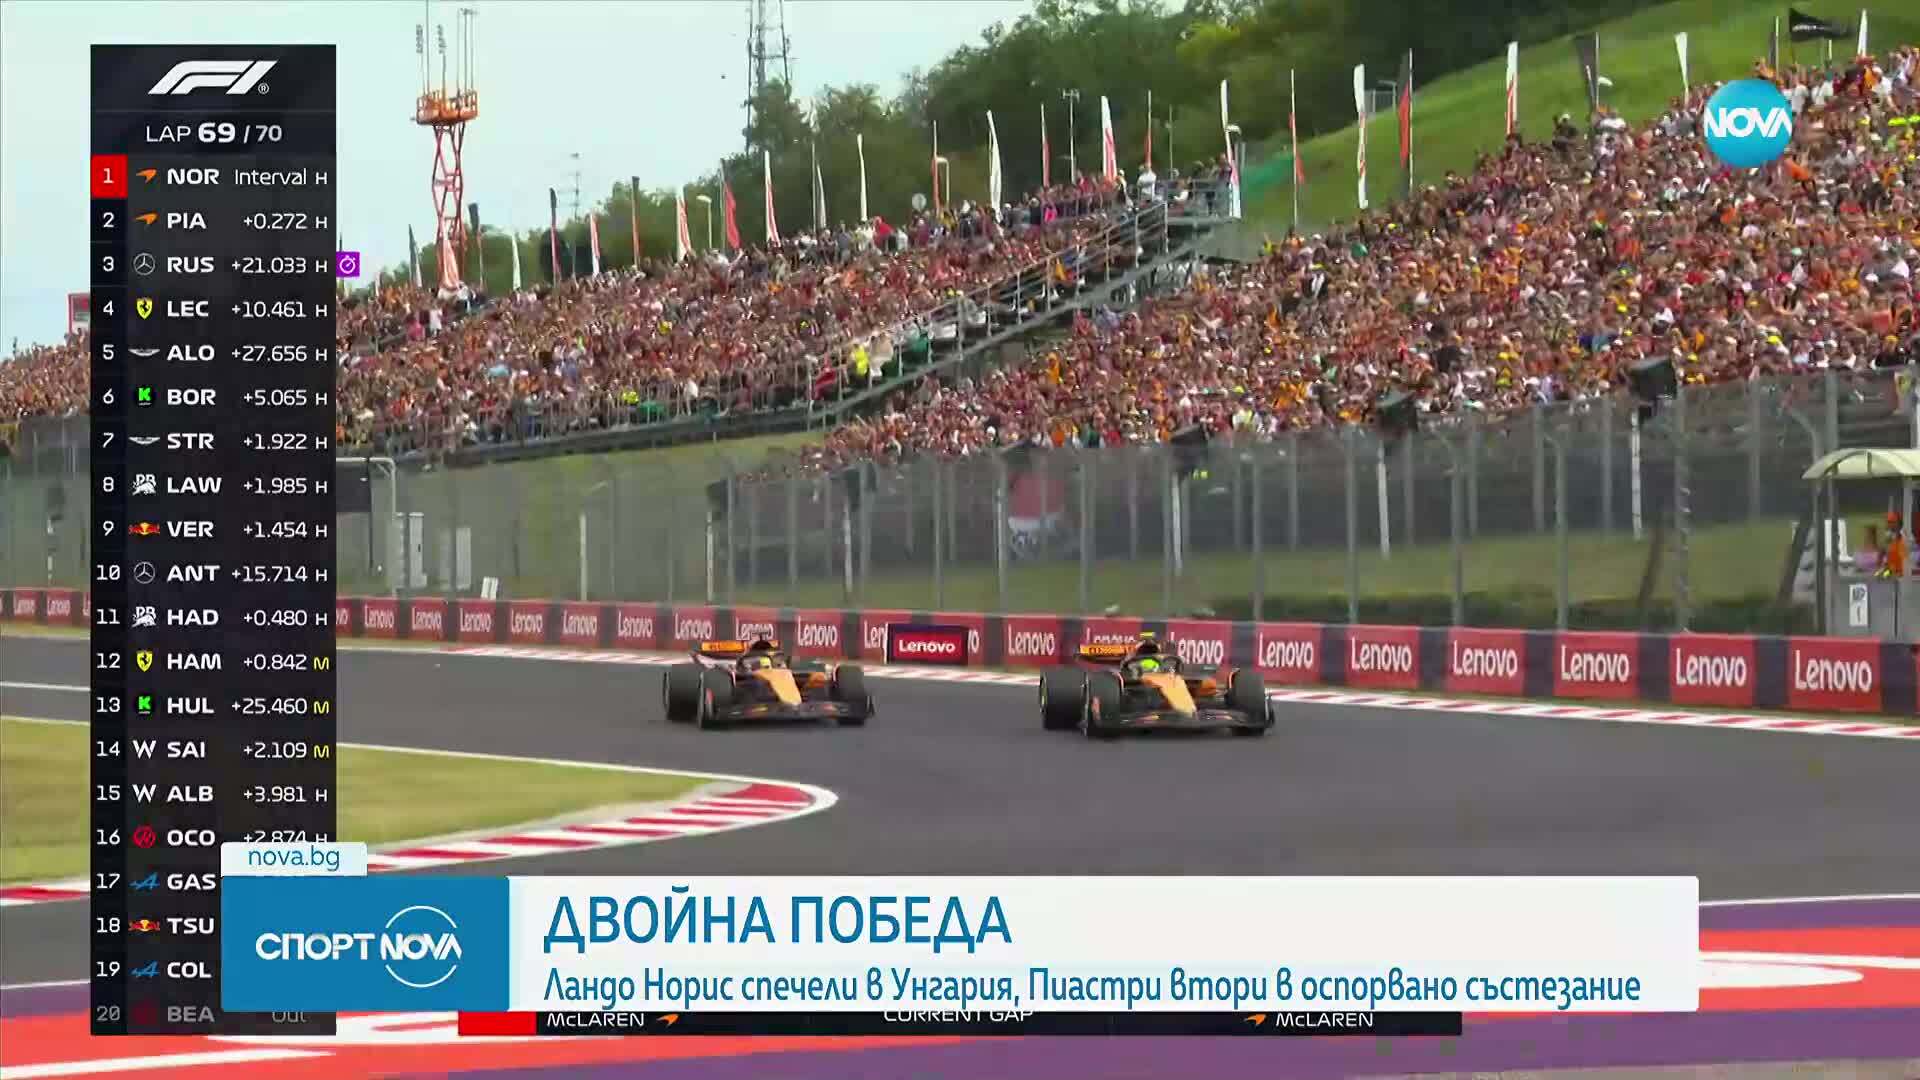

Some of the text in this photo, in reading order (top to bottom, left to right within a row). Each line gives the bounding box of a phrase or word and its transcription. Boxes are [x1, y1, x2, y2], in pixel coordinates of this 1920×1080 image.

[459, 607, 492, 633] Lenovo
[617, 612, 653, 638] Lenovo
[797, 616, 838, 647] Lenovo
[899, 639, 956, 654] Lenovo
[1007, 624, 1055, 656] Lenovo
[1258, 632, 1315, 669] Lenovo
[1350, 634, 1413, 673] Lenovo
[1452, 641, 1519, 678] Lenovo
[1561, 645, 1630, 681] Lenovo
[1675, 648, 1747, 688] Lenovo
[1794, 649, 1873, 692] Lenovo
